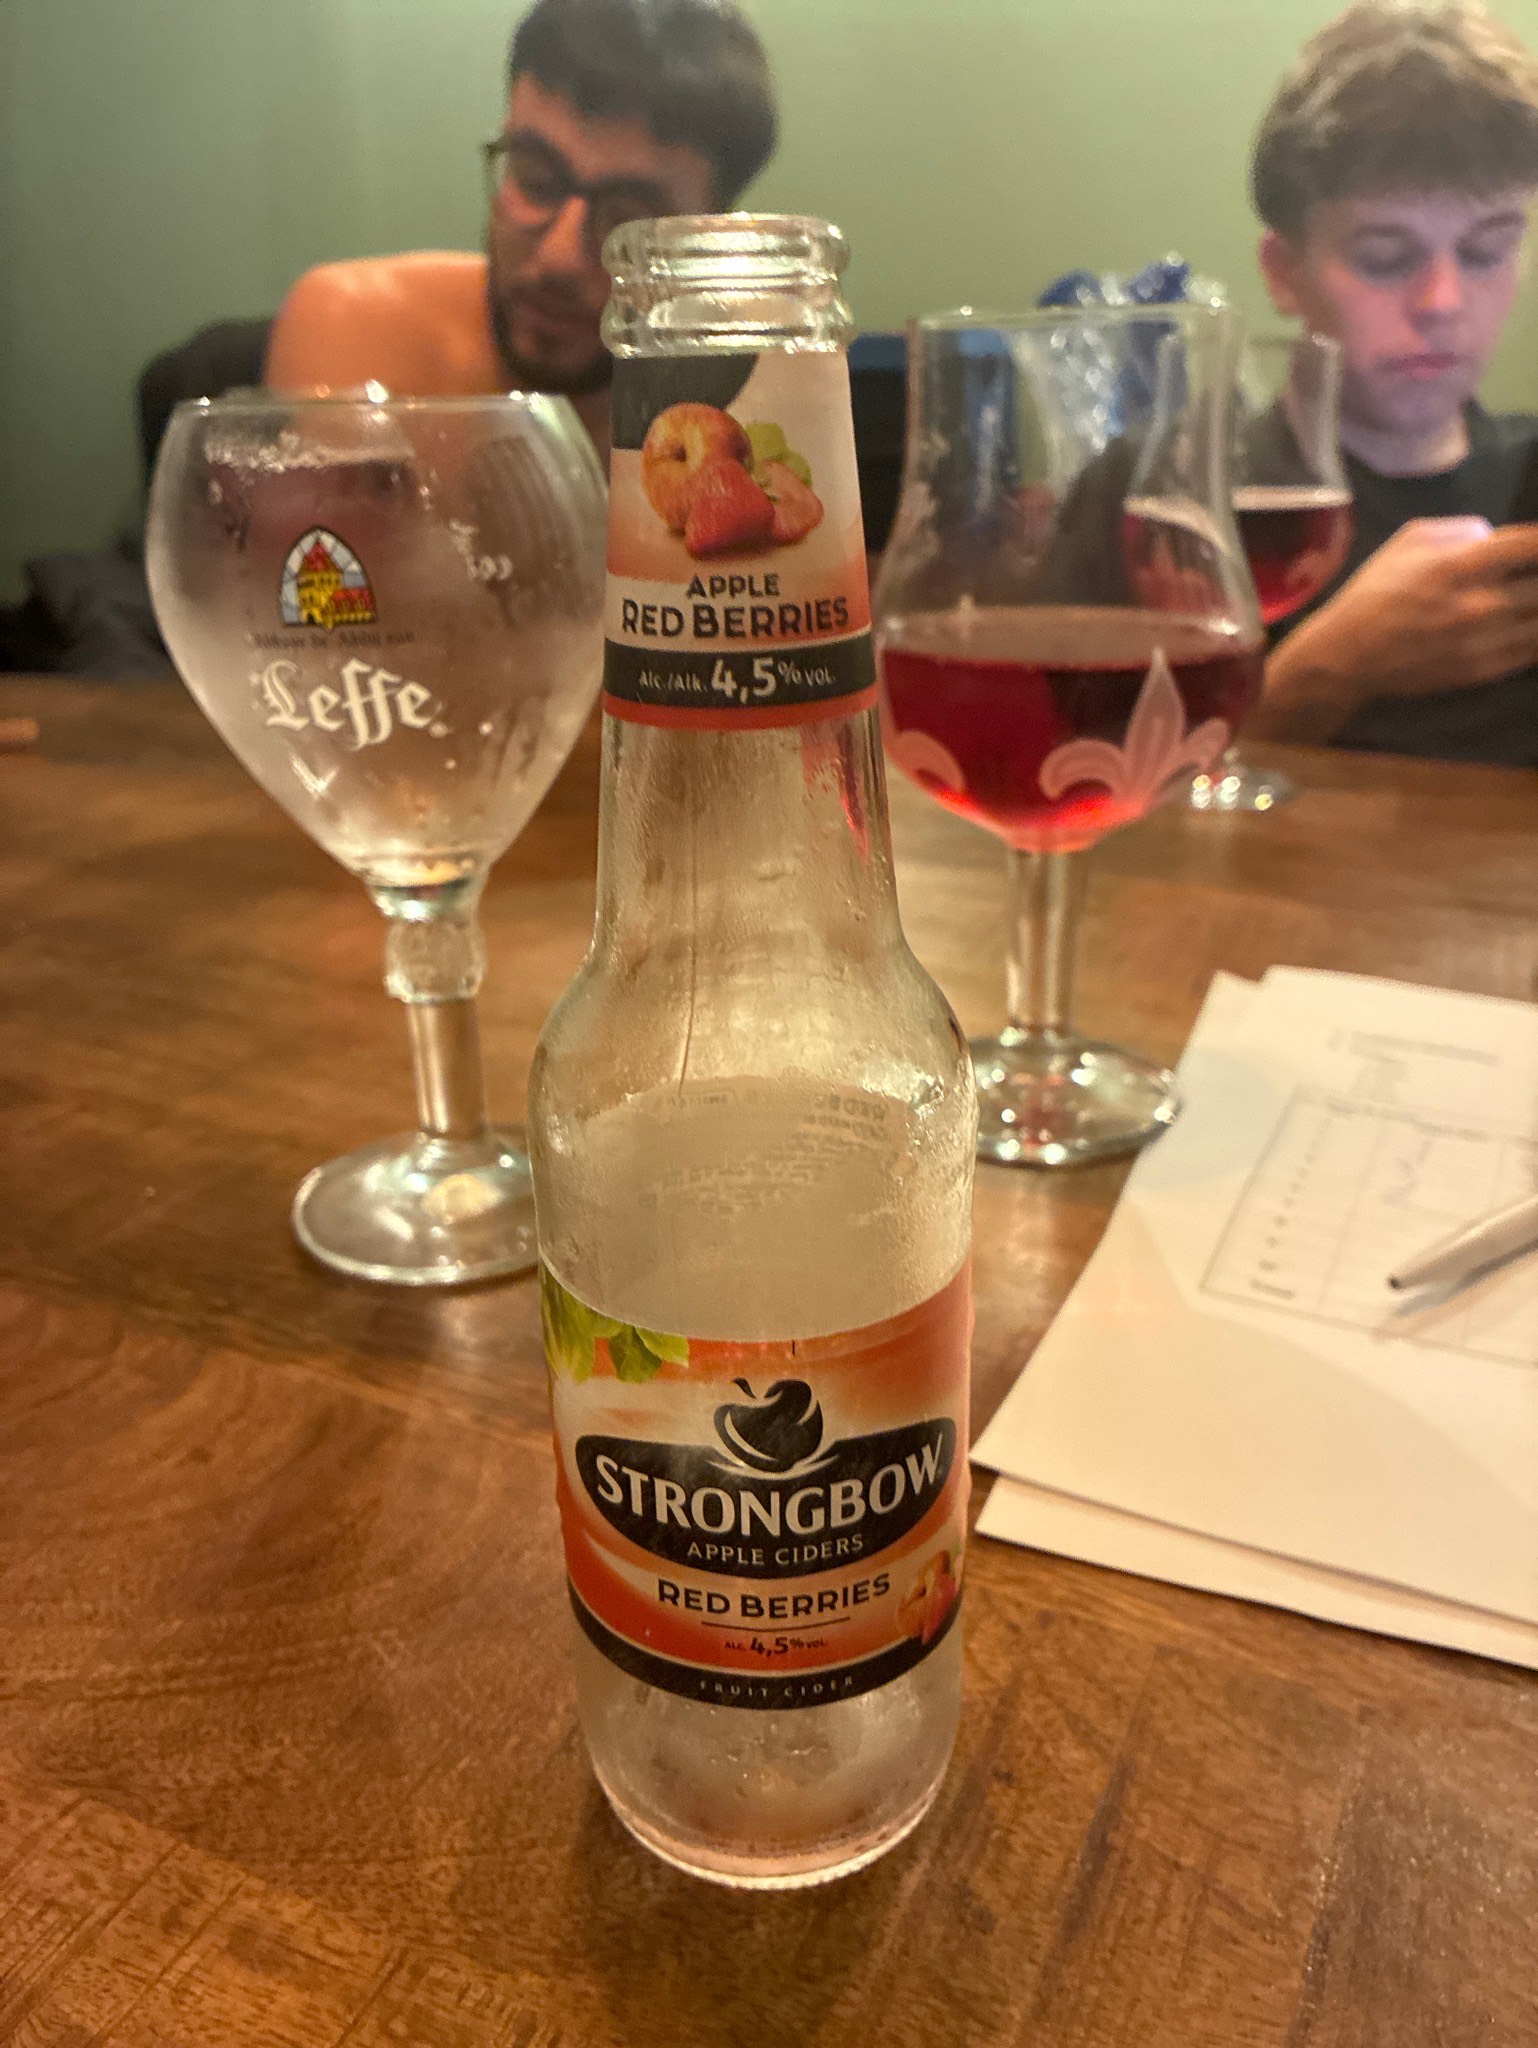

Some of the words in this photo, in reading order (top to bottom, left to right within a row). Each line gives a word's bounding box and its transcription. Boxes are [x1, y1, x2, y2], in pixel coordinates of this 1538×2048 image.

[686, 572, 780, 599] APPLE
[622, 596, 684, 637] RED
[692, 596, 850, 638] BERRIES
[262, 657, 443, 751] Leffe
[595, 1431, 944, 1538] STRONGBOW
[687, 1541, 765, 1565] APPLE
[775, 1533, 864, 1566] CIDERS
[658, 1578, 731, 1615] RED
[740, 1572, 891, 1619] BERRIES
[700, 1679, 768, 1698] FRUIT
[783, 1675, 853, 1697] CIDER
